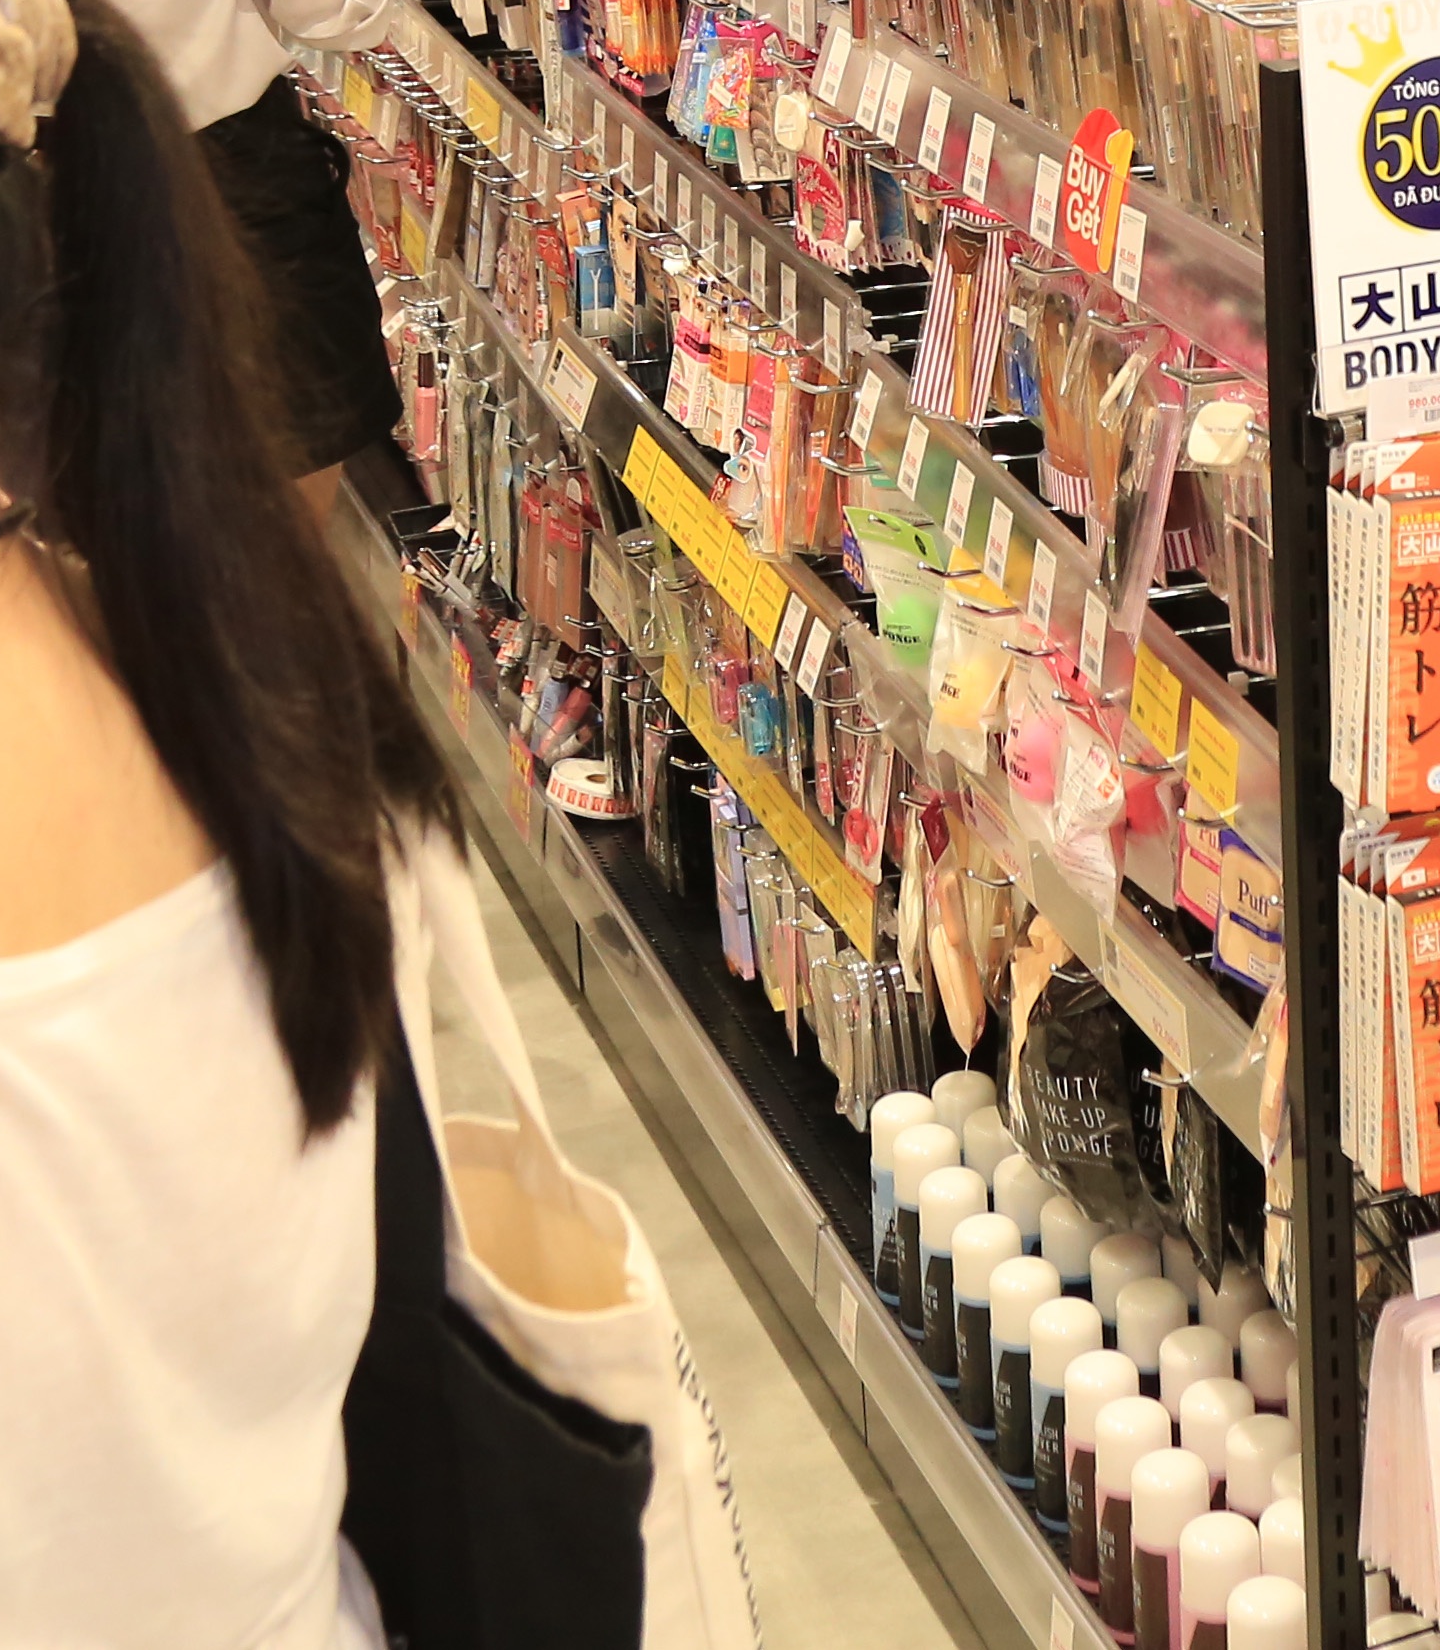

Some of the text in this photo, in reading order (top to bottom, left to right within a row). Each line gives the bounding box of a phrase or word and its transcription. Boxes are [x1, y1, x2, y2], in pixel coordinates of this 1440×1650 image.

[1393, 75, 1440, 101] TỔNG
[1067, 145, 1106, 206] Buy
[1393, 186, 1419, 210] ĐÃ
[1066, 194, 1101, 247] Get
